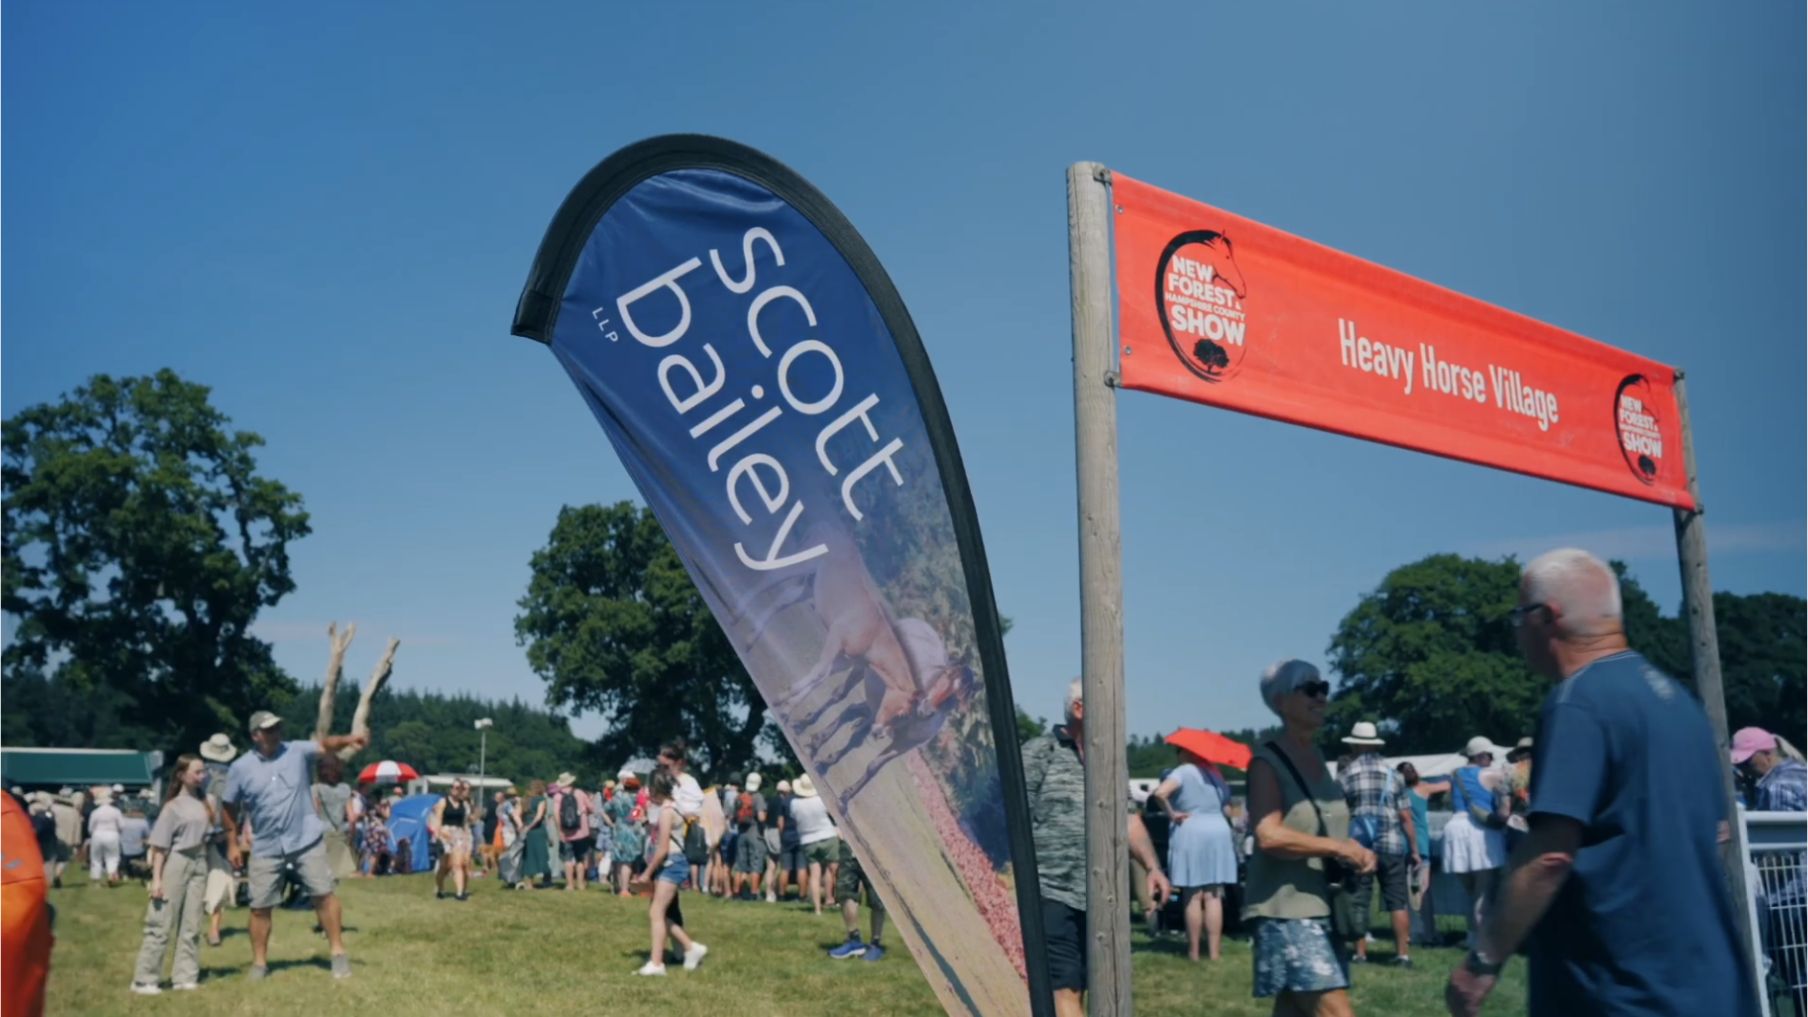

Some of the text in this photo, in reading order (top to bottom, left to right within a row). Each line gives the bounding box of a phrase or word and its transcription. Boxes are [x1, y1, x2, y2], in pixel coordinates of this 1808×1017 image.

[1172, 254, 1214, 282] NEW
[1168, 272, 1235, 308] FOREST
[1170, 303, 1246, 347] SHOW
[709, 226, 905, 522] scott
[1338, 317, 1560, 432] Heavy Horse Village
[616, 256, 830, 571] bailey
[1619, 408, 1656, 431] FOREST
[1620, 394, 1642, 414] NEW
[1623, 430, 1663, 459] SHOW
